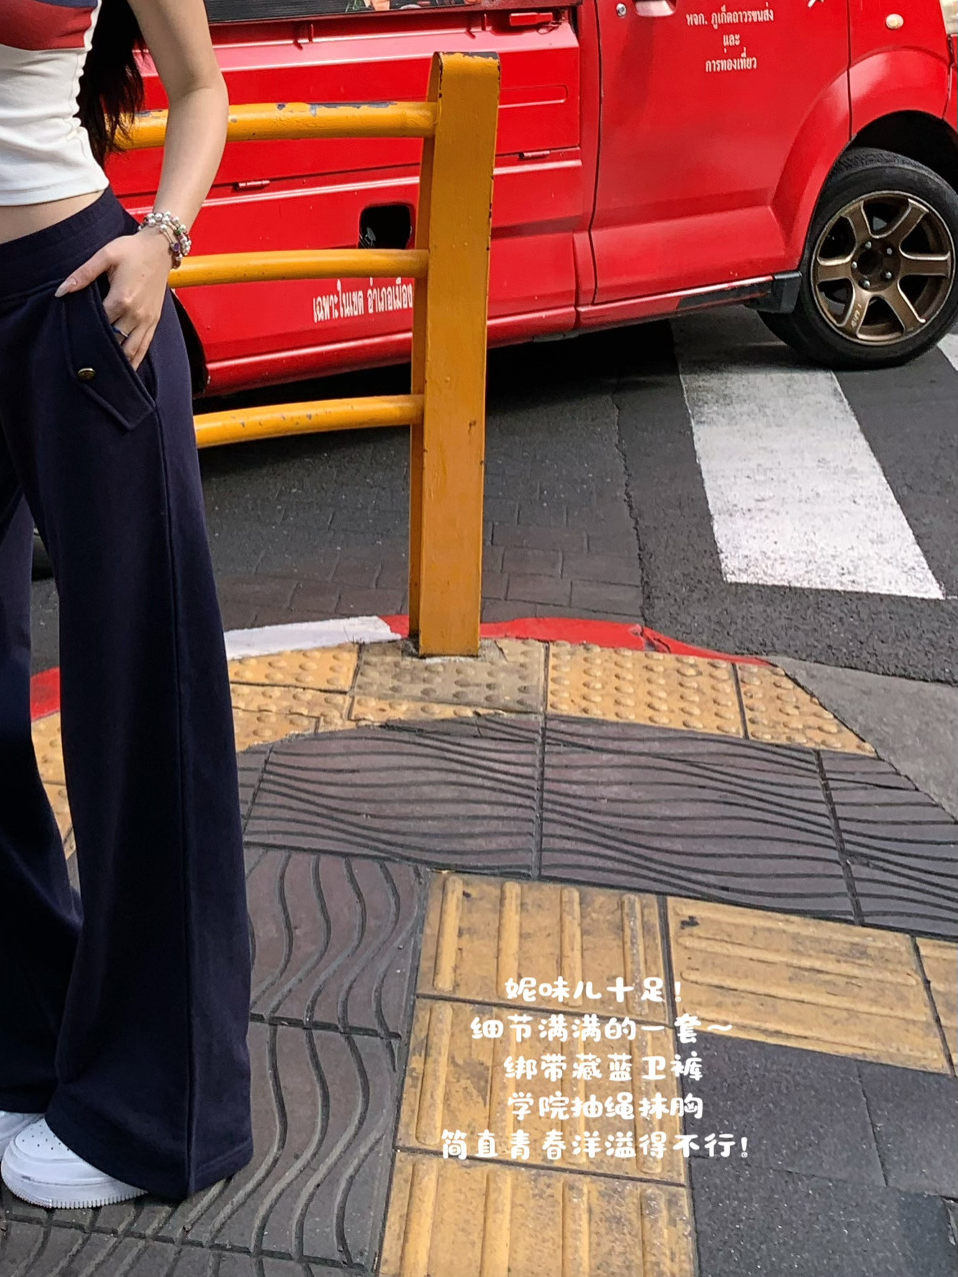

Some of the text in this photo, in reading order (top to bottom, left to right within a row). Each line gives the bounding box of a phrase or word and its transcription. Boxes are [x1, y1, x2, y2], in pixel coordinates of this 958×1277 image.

[686, 2, 774, 30] หจก. ภูเก็ตถาวรขนส่ง
[723, 33, 741, 47] และ
[705, 47, 758, 73] การท่องเที่ยว
[313, 279, 365, 323] เฉพาะในเขต
